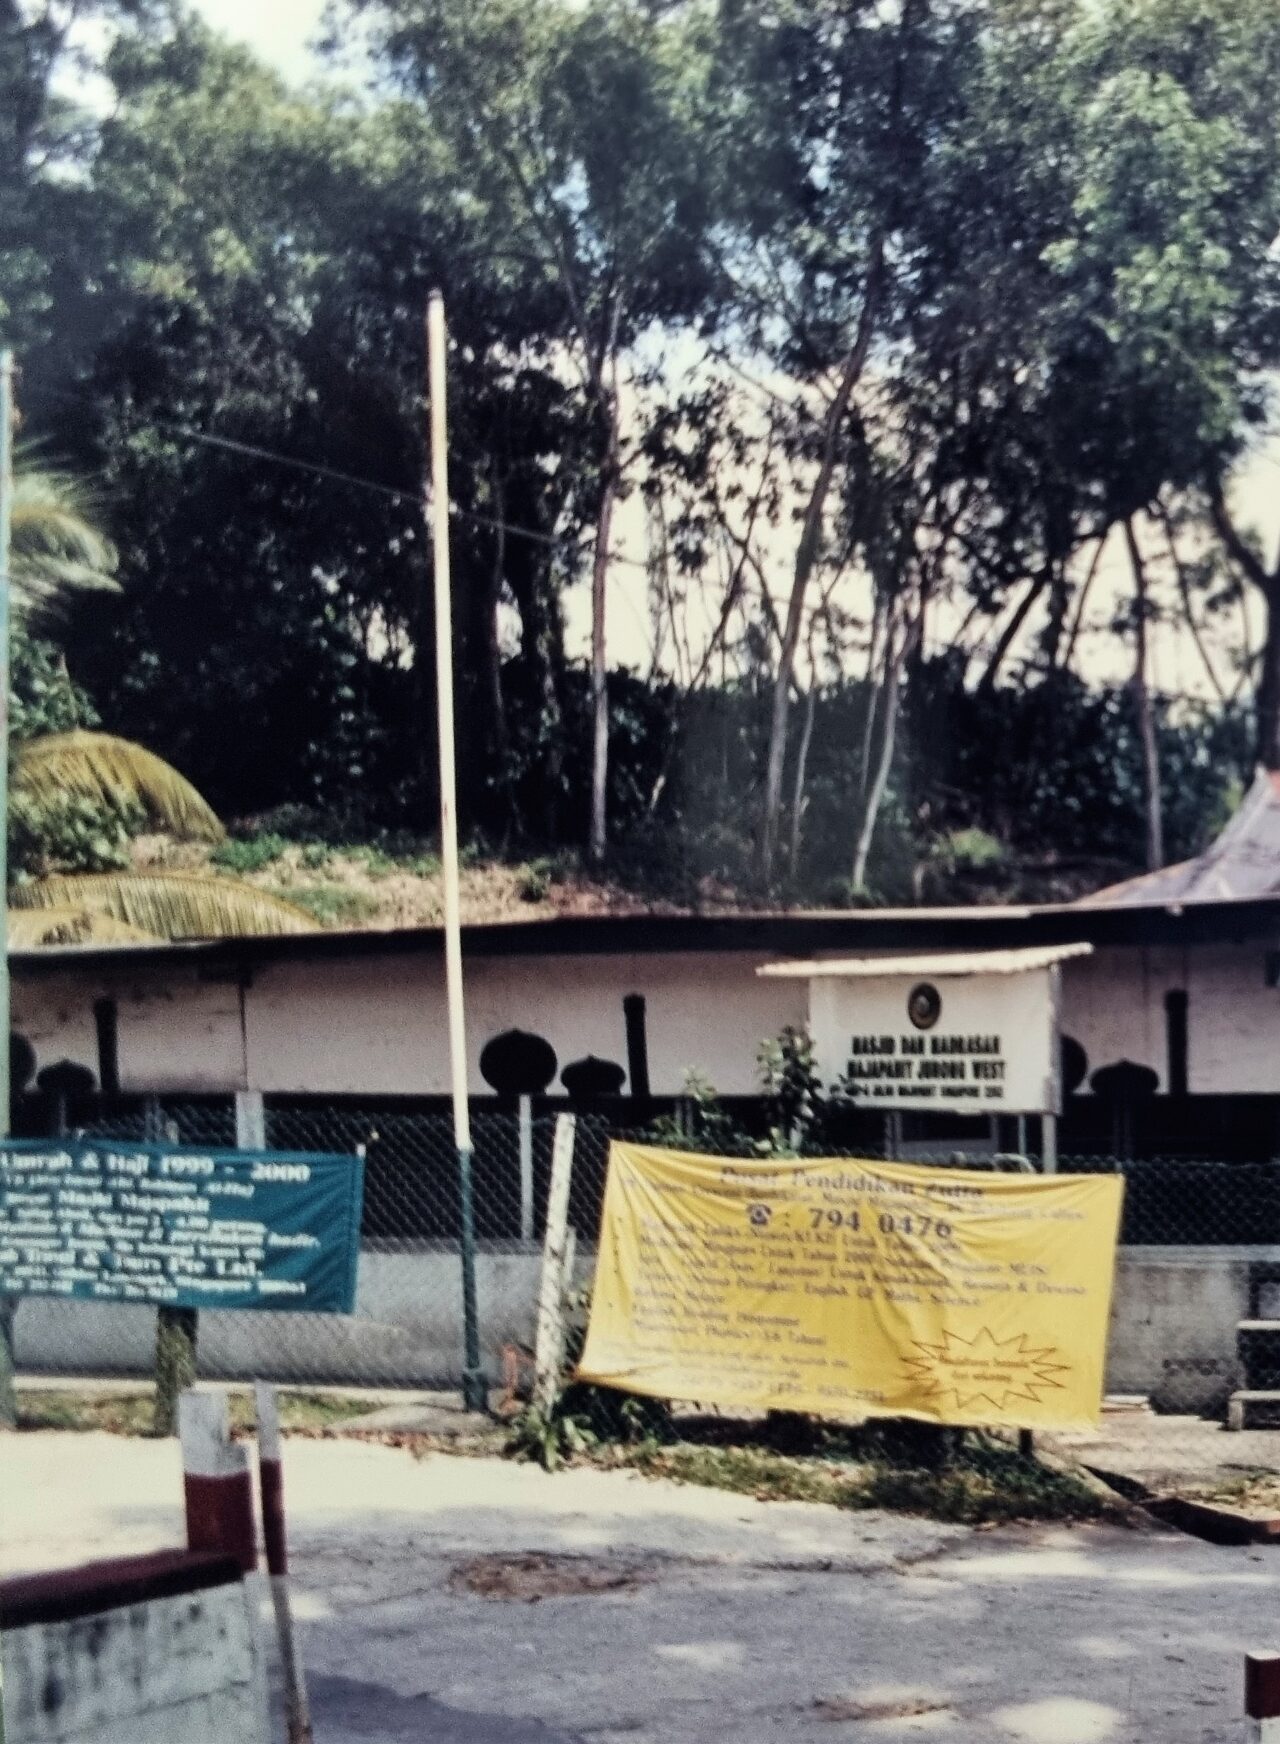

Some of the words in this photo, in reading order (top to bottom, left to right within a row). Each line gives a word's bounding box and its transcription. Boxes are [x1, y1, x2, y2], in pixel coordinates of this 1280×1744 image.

[972, 1060, 1005, 1079] WEST
[809, 1208, 859, 1230] 794
[878, 1213, 952, 1238] 0476
